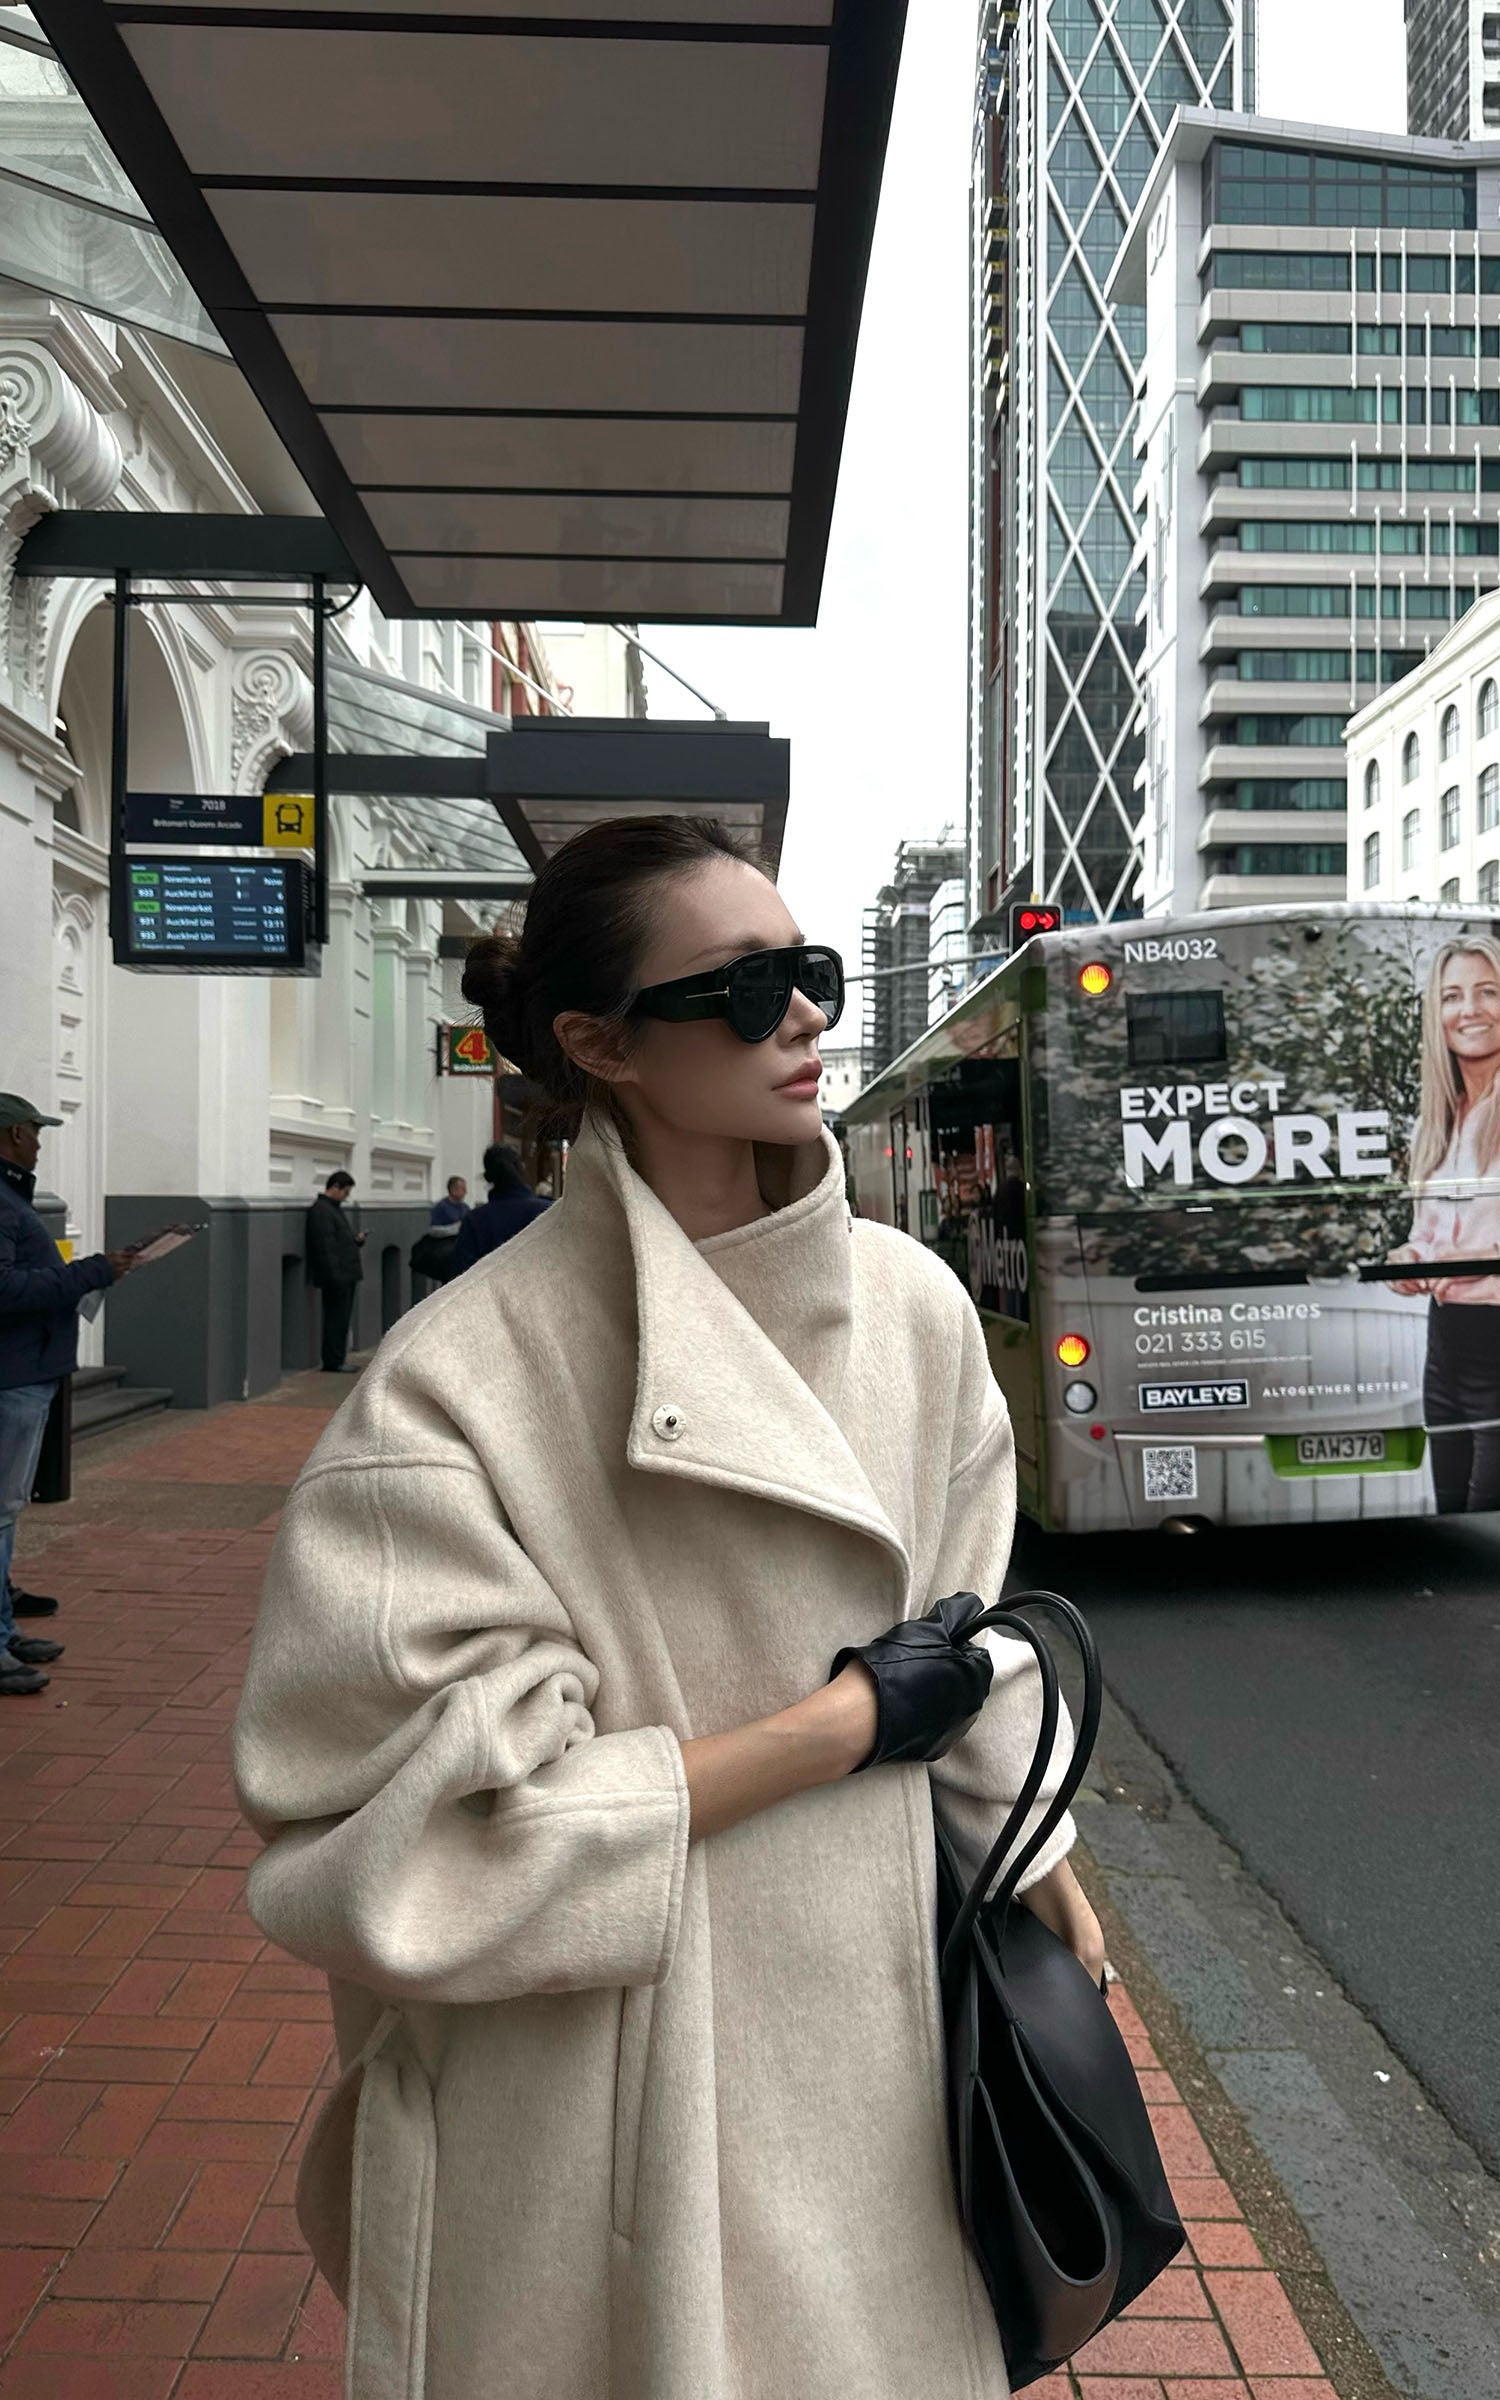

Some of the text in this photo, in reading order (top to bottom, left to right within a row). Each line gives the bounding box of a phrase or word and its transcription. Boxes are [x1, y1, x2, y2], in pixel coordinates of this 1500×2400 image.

[153, 818, 187, 828] Britomart
[217, 821, 243, 830] Arcade
[163, 875, 212, 885] Newmarket
[263, 877, 284, 887] Now
[198, 889, 214, 899] Uni
[164, 903, 213, 913] Newmarket
[199, 918, 215, 927] Uni
[262, 919, 285, 929] 13:11
[200, 932, 216, 942] Uni
[263, 933, 285, 943] 13:11
[1123, 938, 1218, 963] NB4032
[455, 1029, 490, 1064] 4
[1120, 1079, 1286, 1119] EXPECT
[1122, 1110, 1392, 1188] MORE
[981, 1217, 1029, 1293] Metro
[1133, 1302, 1321, 1327] Cristina Casares
[1135, 1328, 1266, 1354] 021 333 615
[1146, 1385, 1243, 1408] BAYLEYS
[1262, 1381, 1409, 1398] ALTOGETHER BETTER
